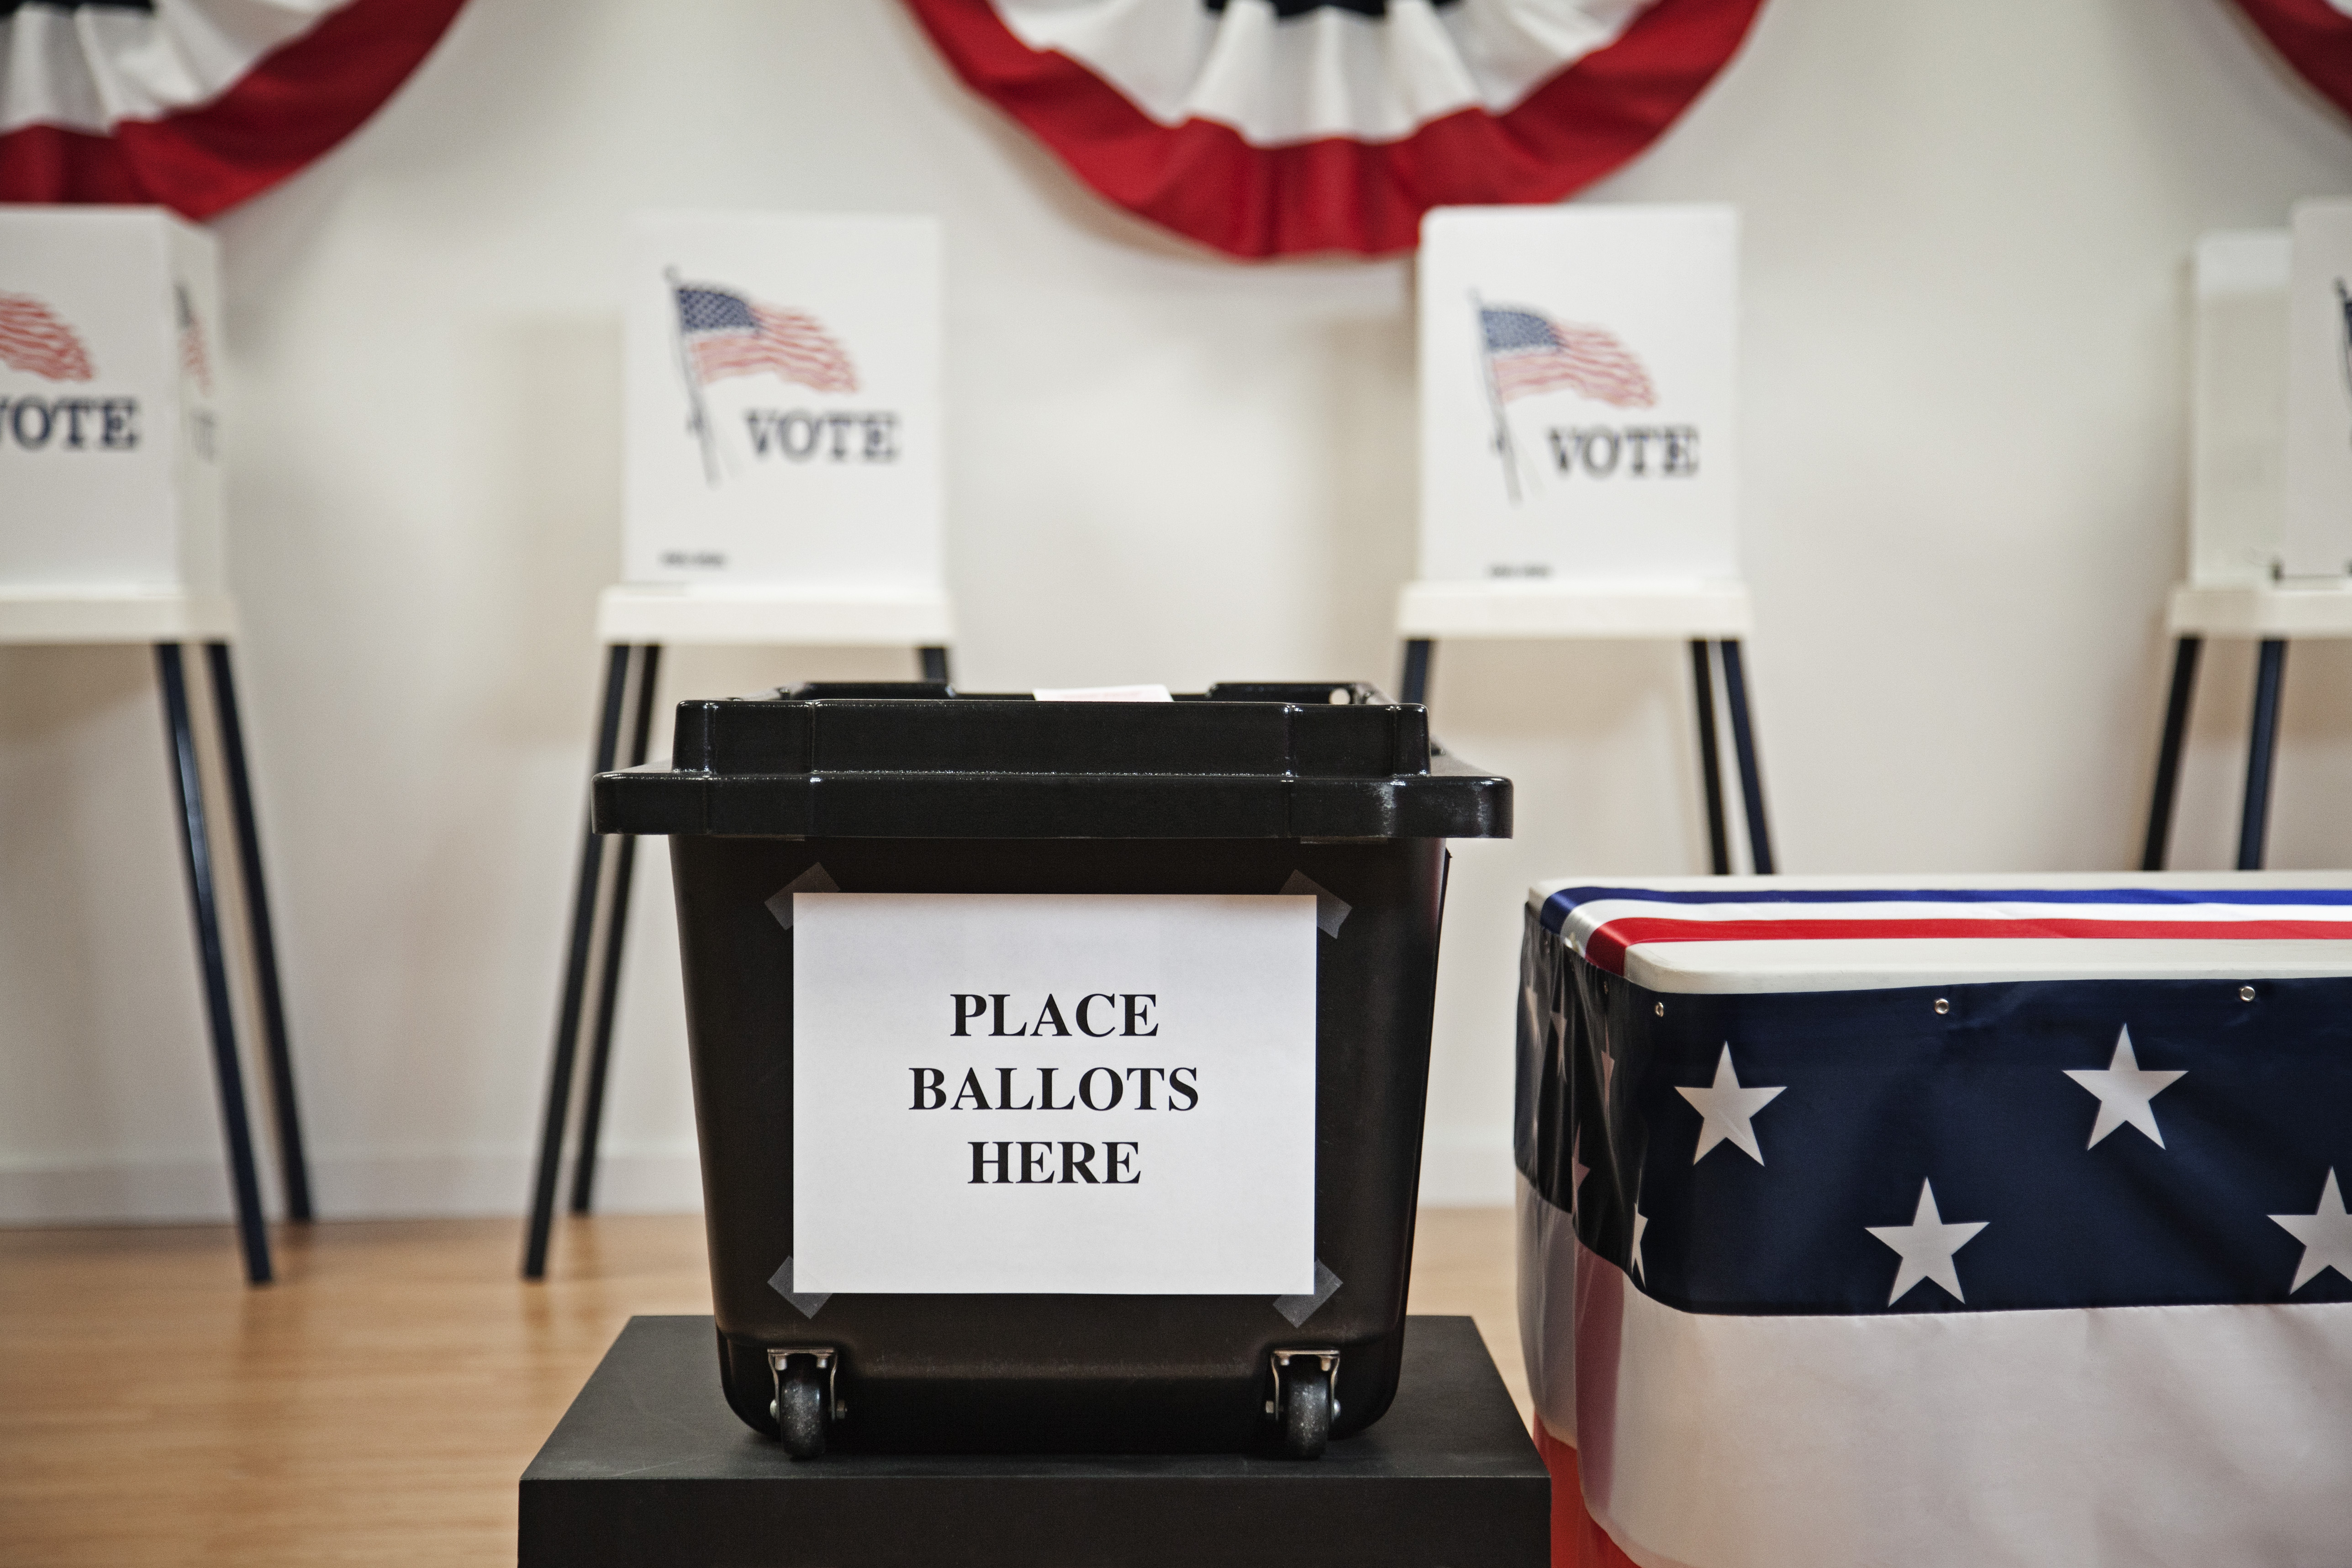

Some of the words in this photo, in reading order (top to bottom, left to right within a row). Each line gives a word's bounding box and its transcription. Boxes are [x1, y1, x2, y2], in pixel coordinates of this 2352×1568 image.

[744, 409, 899, 462] VOTE
[1548, 425, 1699, 477] VOTE
[950, 994, 1159, 1037] PLACE
[909, 1067, 1198, 1111] BALLOTS
[968, 1142, 1141, 1184] HERE
